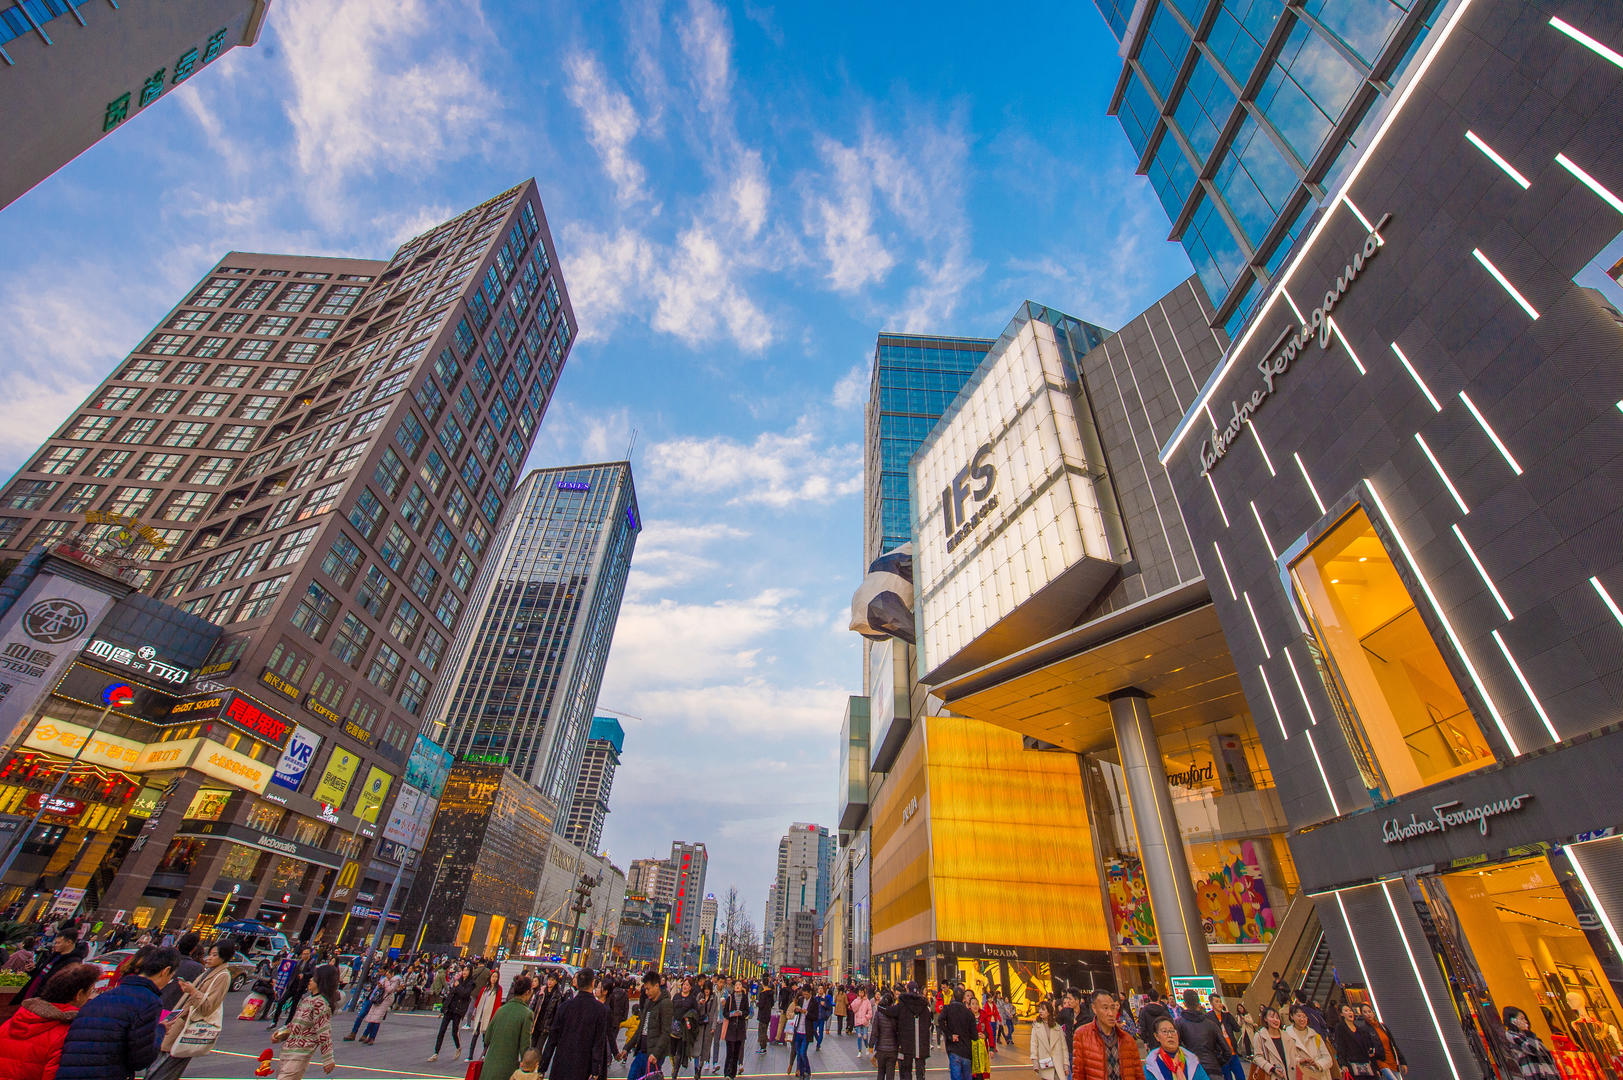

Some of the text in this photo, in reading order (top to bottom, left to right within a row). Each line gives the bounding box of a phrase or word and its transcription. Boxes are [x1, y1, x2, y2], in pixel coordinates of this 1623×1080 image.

[1200, 212, 1393, 477] Salvatore Ferragamo
[942, 442, 997, 538] IFS
[193, 697, 223, 711] SCHOOL
[313, 702, 340, 723] COFFEE
[290, 738, 313, 764] VR
[1166, 761, 1214, 790] rawford
[1381, 793, 1535, 844] Salvatore Ferragamo
[986, 948, 1019, 959] PRADA
